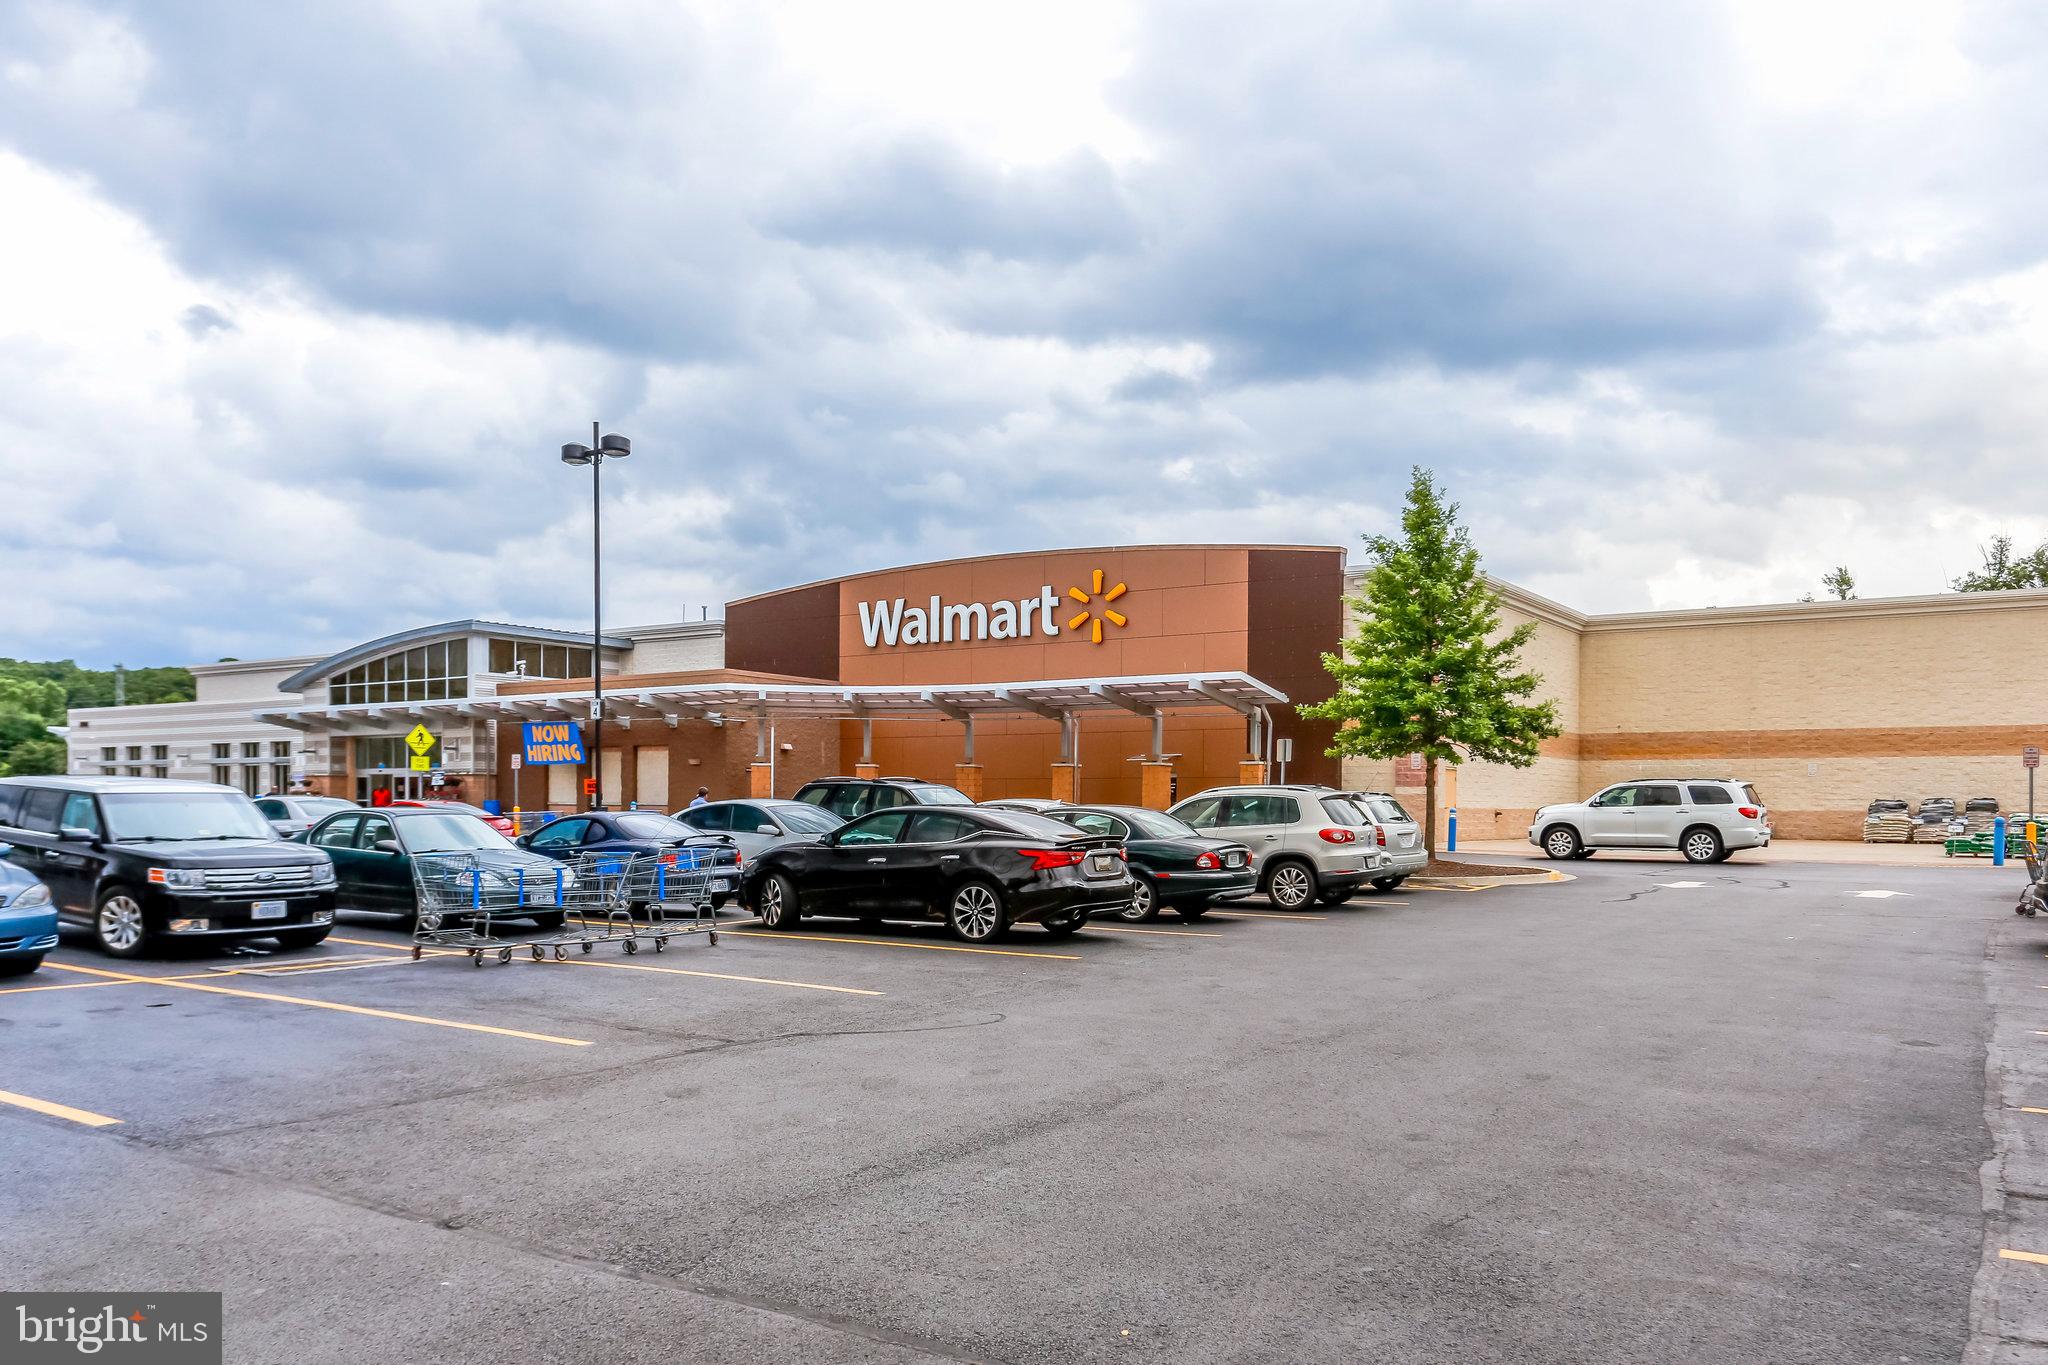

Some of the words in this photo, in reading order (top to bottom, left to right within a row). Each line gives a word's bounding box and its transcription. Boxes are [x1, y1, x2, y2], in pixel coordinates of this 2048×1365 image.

[857, 584, 1059, 648] Walmart
[532, 725, 569, 742] NOW
[527, 744, 581, 761] HIRING
